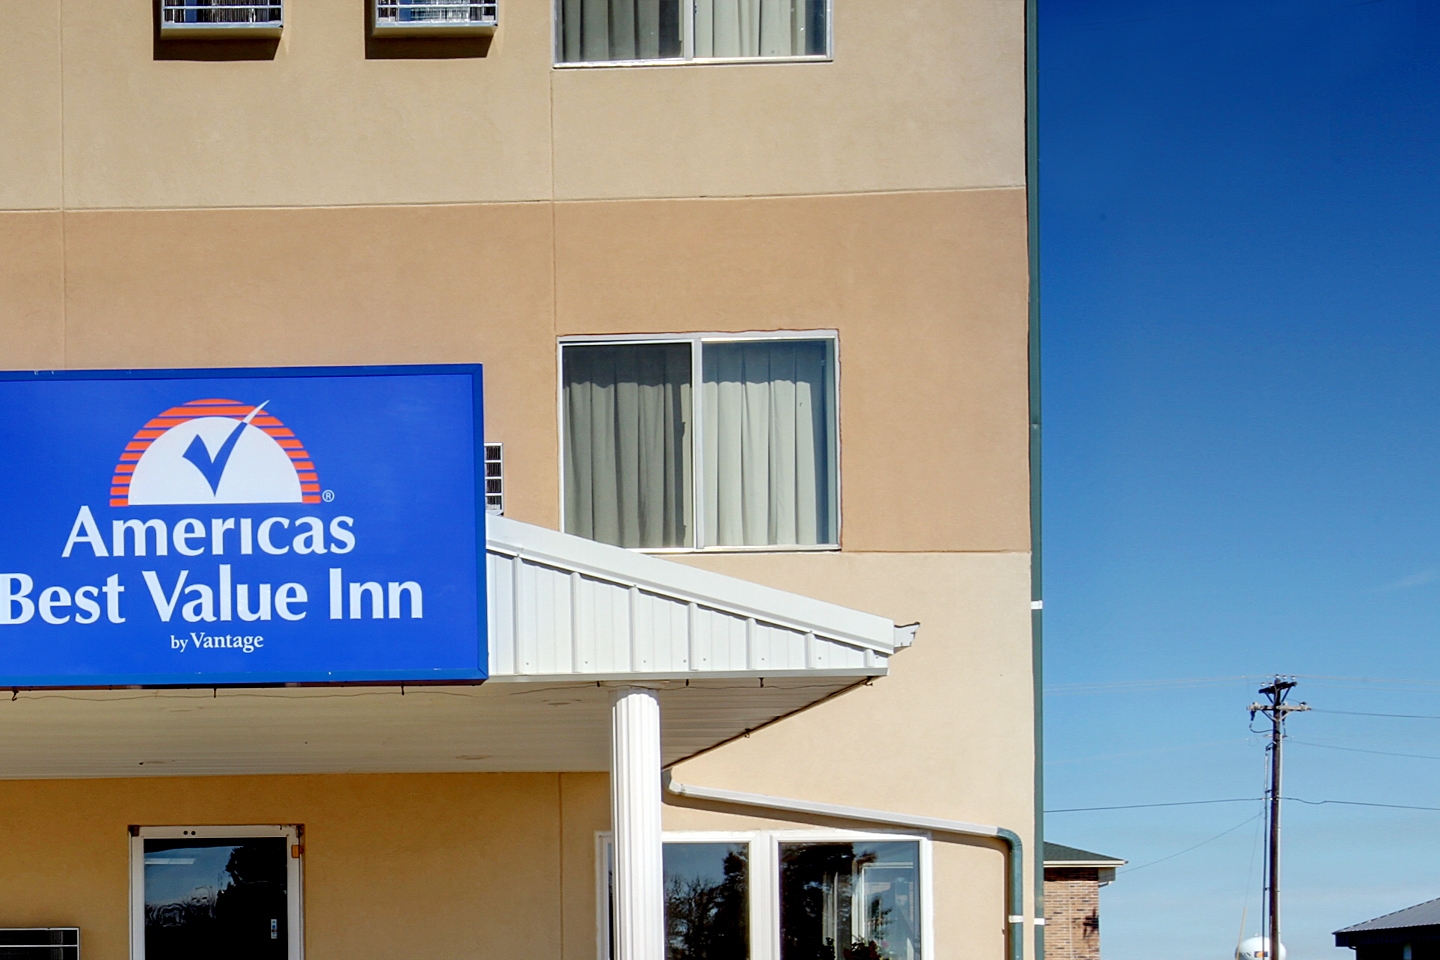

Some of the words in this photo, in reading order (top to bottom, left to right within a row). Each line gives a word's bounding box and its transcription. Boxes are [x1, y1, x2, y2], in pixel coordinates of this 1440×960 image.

[61, 505, 356, 558] Americas
[141, 564, 309, 623] Value
[329, 568, 424, 620] Inn
[170, 634, 188, 653] by
[190, 632, 265, 653] Vantage
